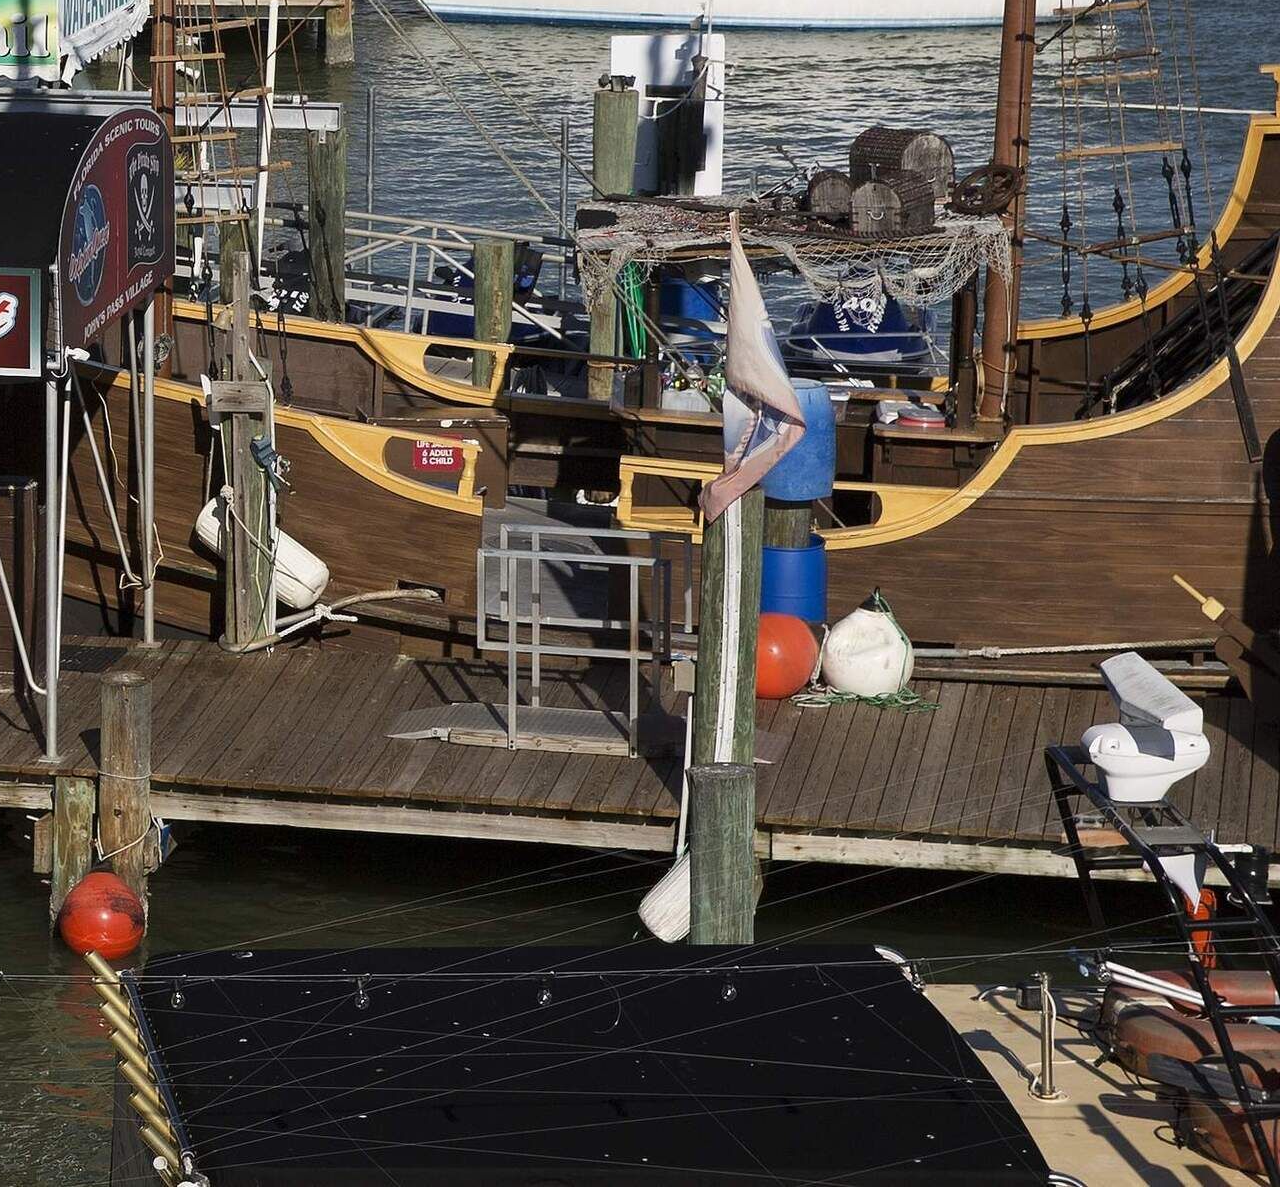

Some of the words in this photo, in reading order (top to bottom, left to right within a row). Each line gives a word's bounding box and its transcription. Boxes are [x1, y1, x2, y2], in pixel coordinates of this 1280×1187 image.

[104, 120, 133, 147] SCENIC
[134, 118, 160, 136] TOURS
[106, 294, 124, 320] PASS
[125, 270, 154, 302] VILLAGE
[429, 449, 453, 457] ADULT
